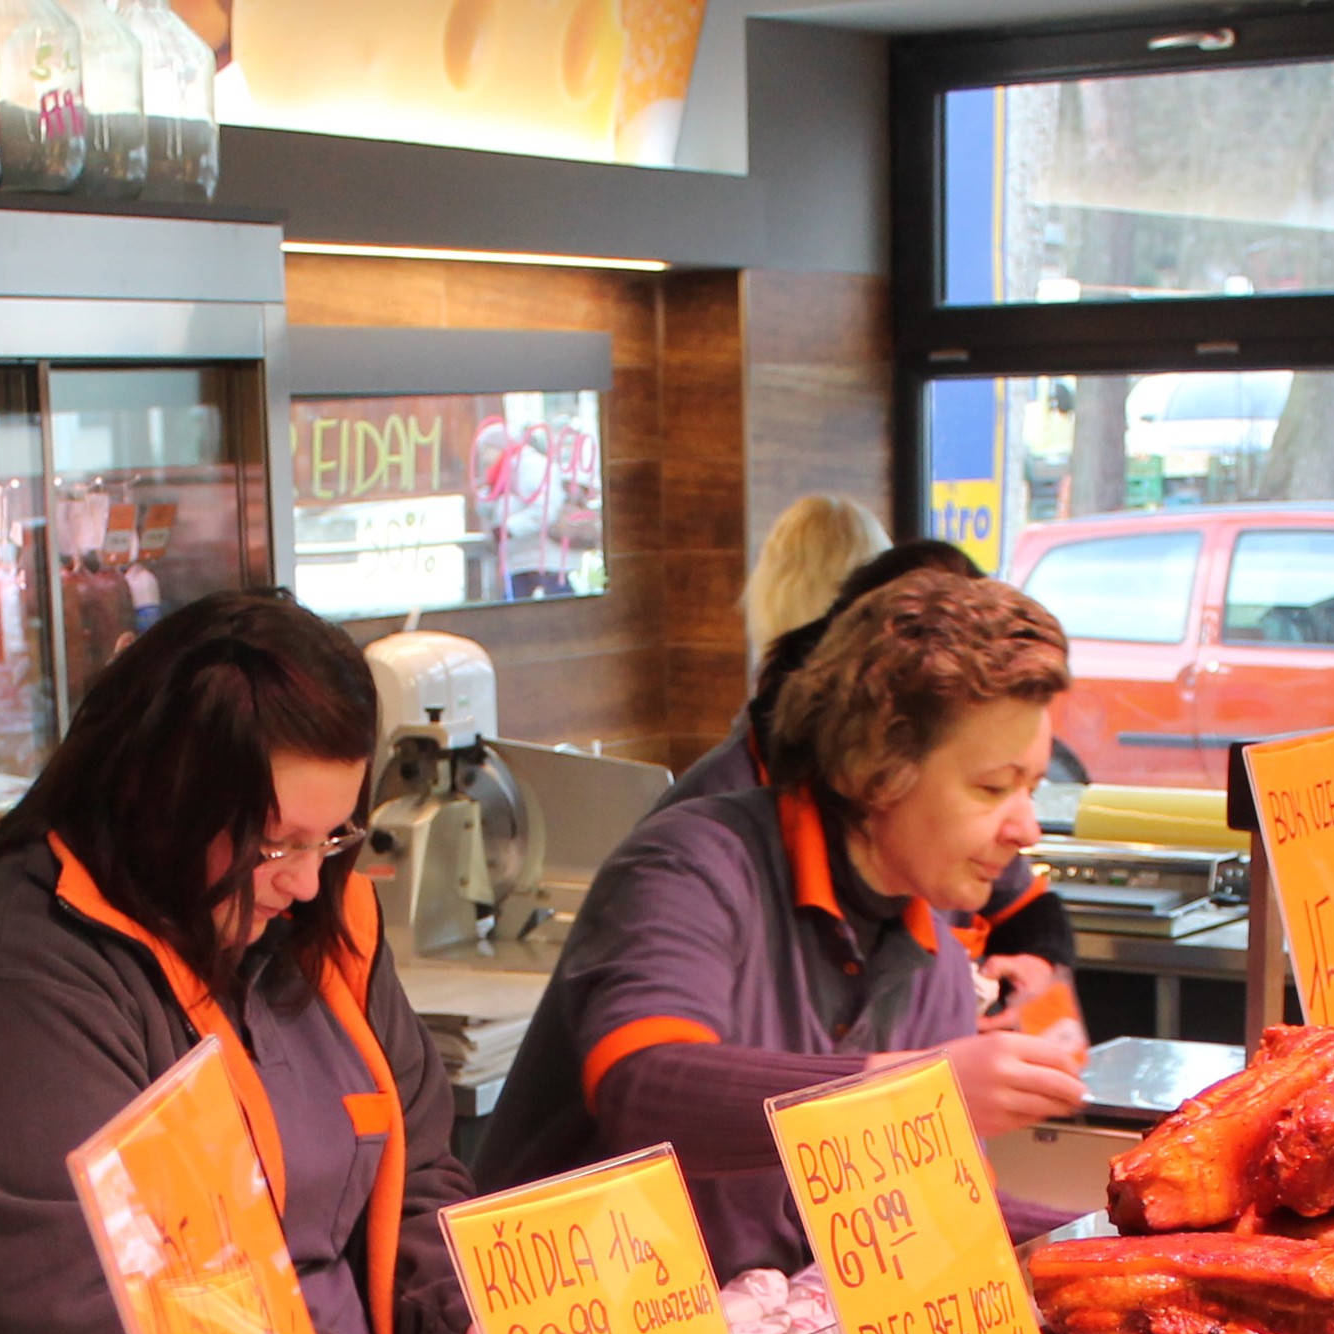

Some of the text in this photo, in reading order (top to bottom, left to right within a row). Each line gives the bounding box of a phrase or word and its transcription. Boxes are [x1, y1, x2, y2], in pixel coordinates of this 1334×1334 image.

[313, 414, 442, 499] EIDAM
[1268, 790, 1310, 846] BOK
[797, 1093, 953, 1206] BOK S KOSTÍ
[473, 1220, 599, 1313] KŘÍDLA
[633, 1270, 715, 1334] CHLAZENÁ
